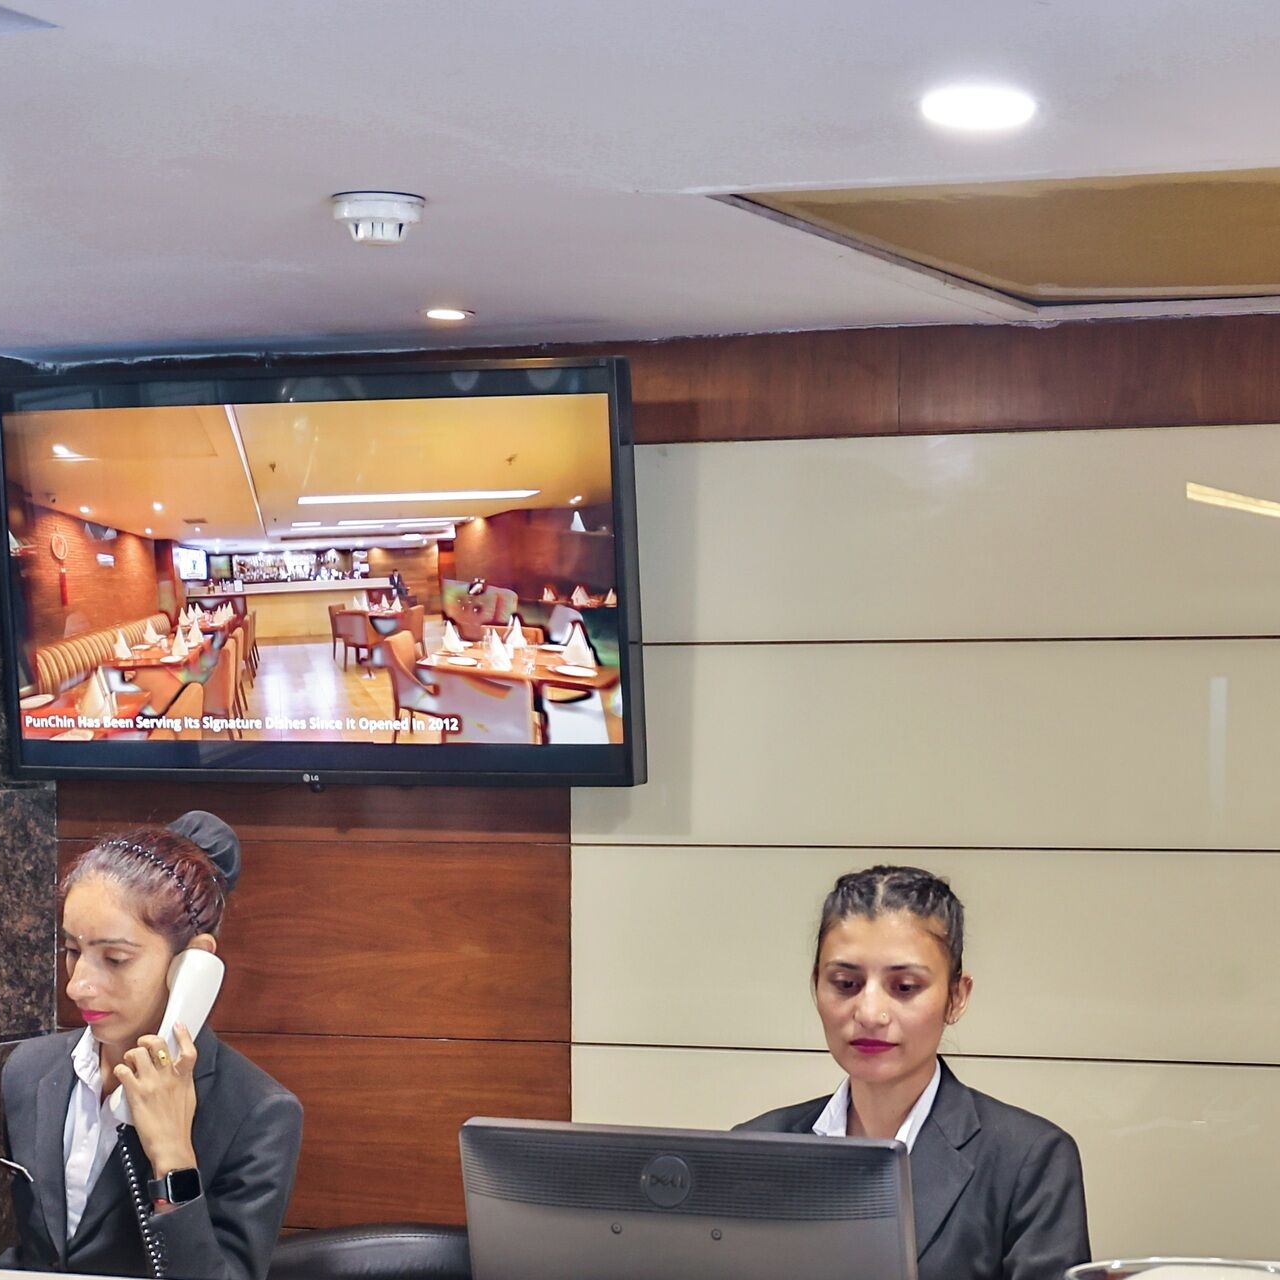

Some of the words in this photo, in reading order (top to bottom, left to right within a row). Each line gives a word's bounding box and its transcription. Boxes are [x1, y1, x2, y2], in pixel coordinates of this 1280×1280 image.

[25, 715, 75, 728] PunChin
[77, 716, 100, 729] Has
[103, 716, 133, 729] Been
[135, 716, 181, 732] Serving
[184, 716, 200, 729] Its
[202, 716, 262, 732] Signature
[265, 717, 306, 730] Dishes
[309, 717, 342, 730] Since
[346, 717, 356, 730] It
[358, 717, 409, 733] Opened
[412, 718, 425, 731] In
[428, 717, 459, 731] 2012
